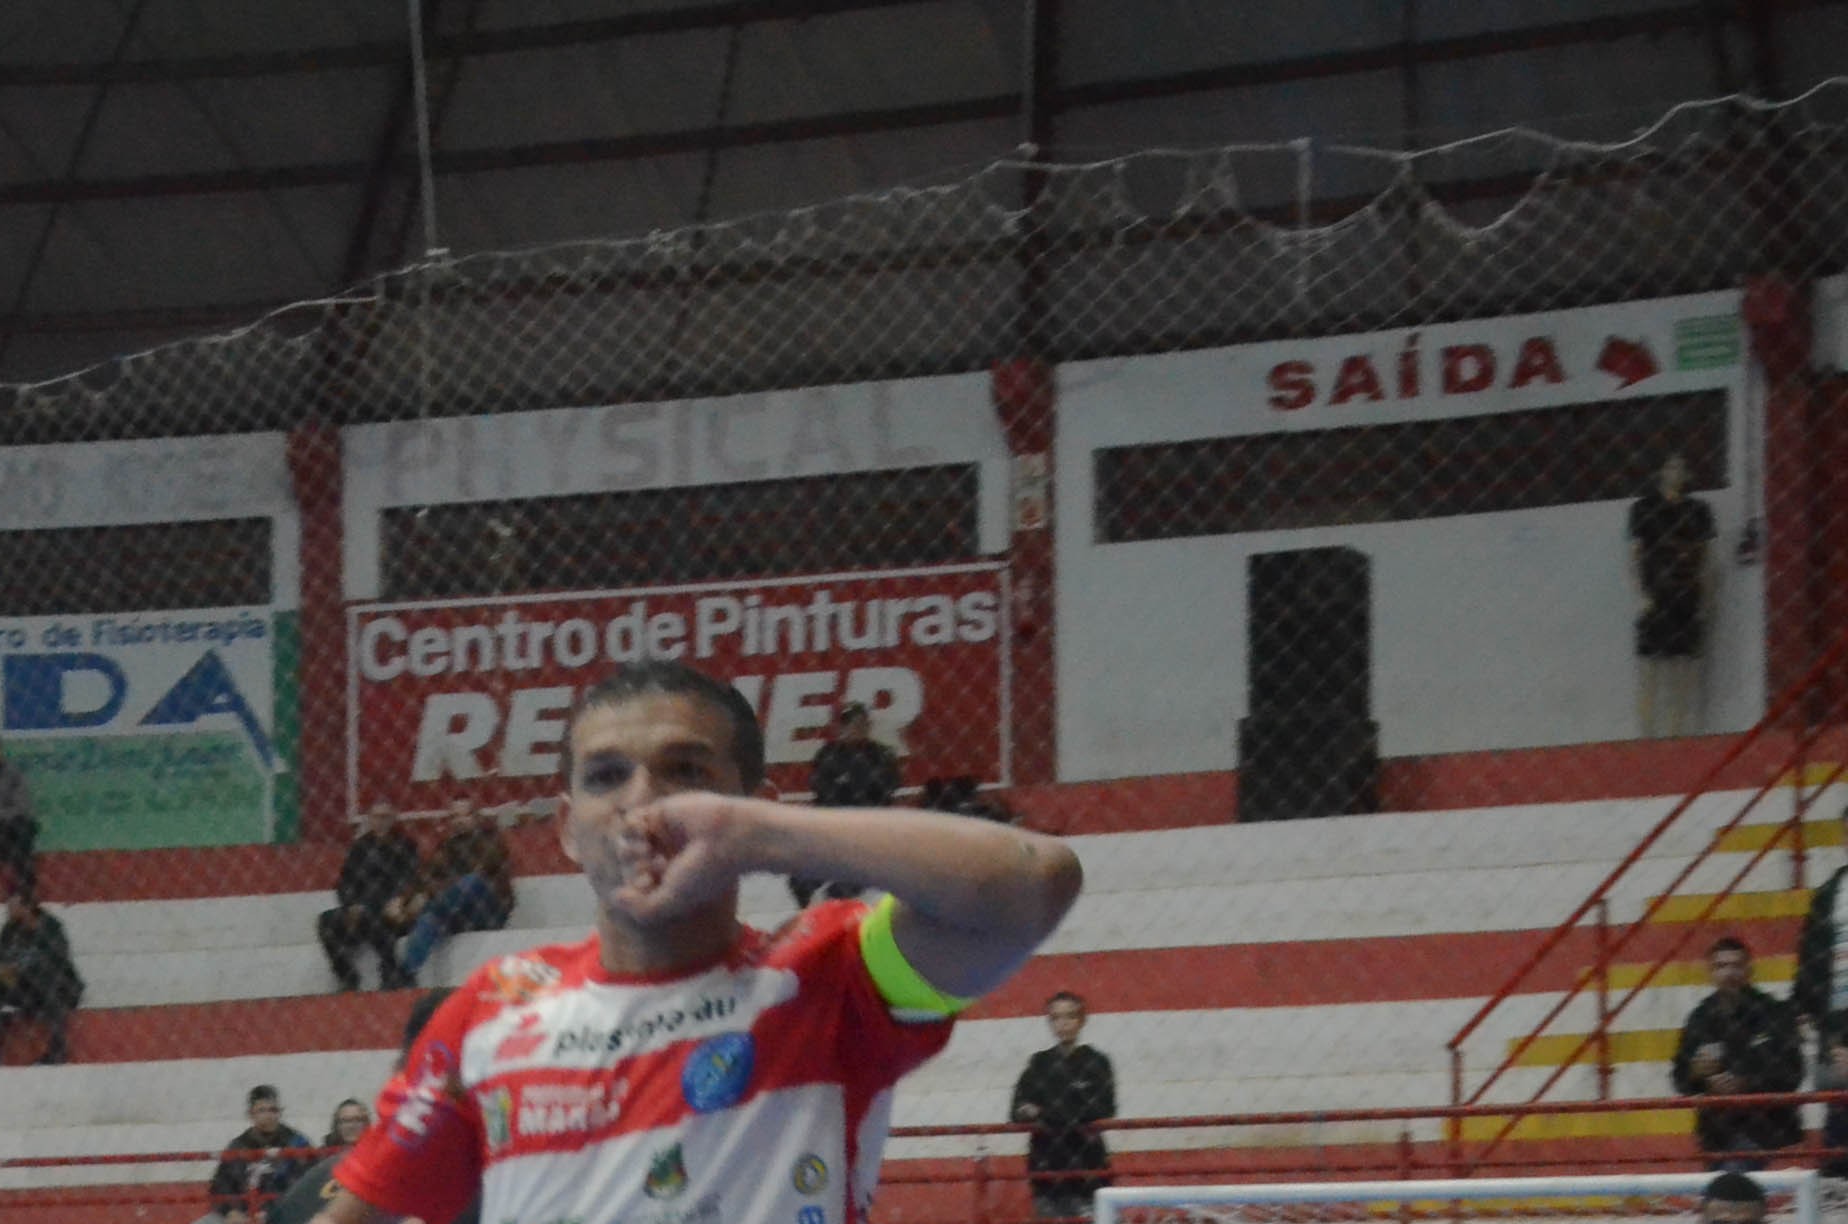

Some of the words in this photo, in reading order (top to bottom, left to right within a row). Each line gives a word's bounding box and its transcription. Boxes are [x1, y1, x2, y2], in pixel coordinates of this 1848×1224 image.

[1267, 333, 1567, 410] SAÍDA
[42, 619, 81, 648] de
[91, 611, 267, 648] Fisioterapia
[358, 609, 597, 681] Centro
[606, 600, 685, 663] de
[696, 586, 997, 660] Pinturas
[413, 665, 924, 782] REER
